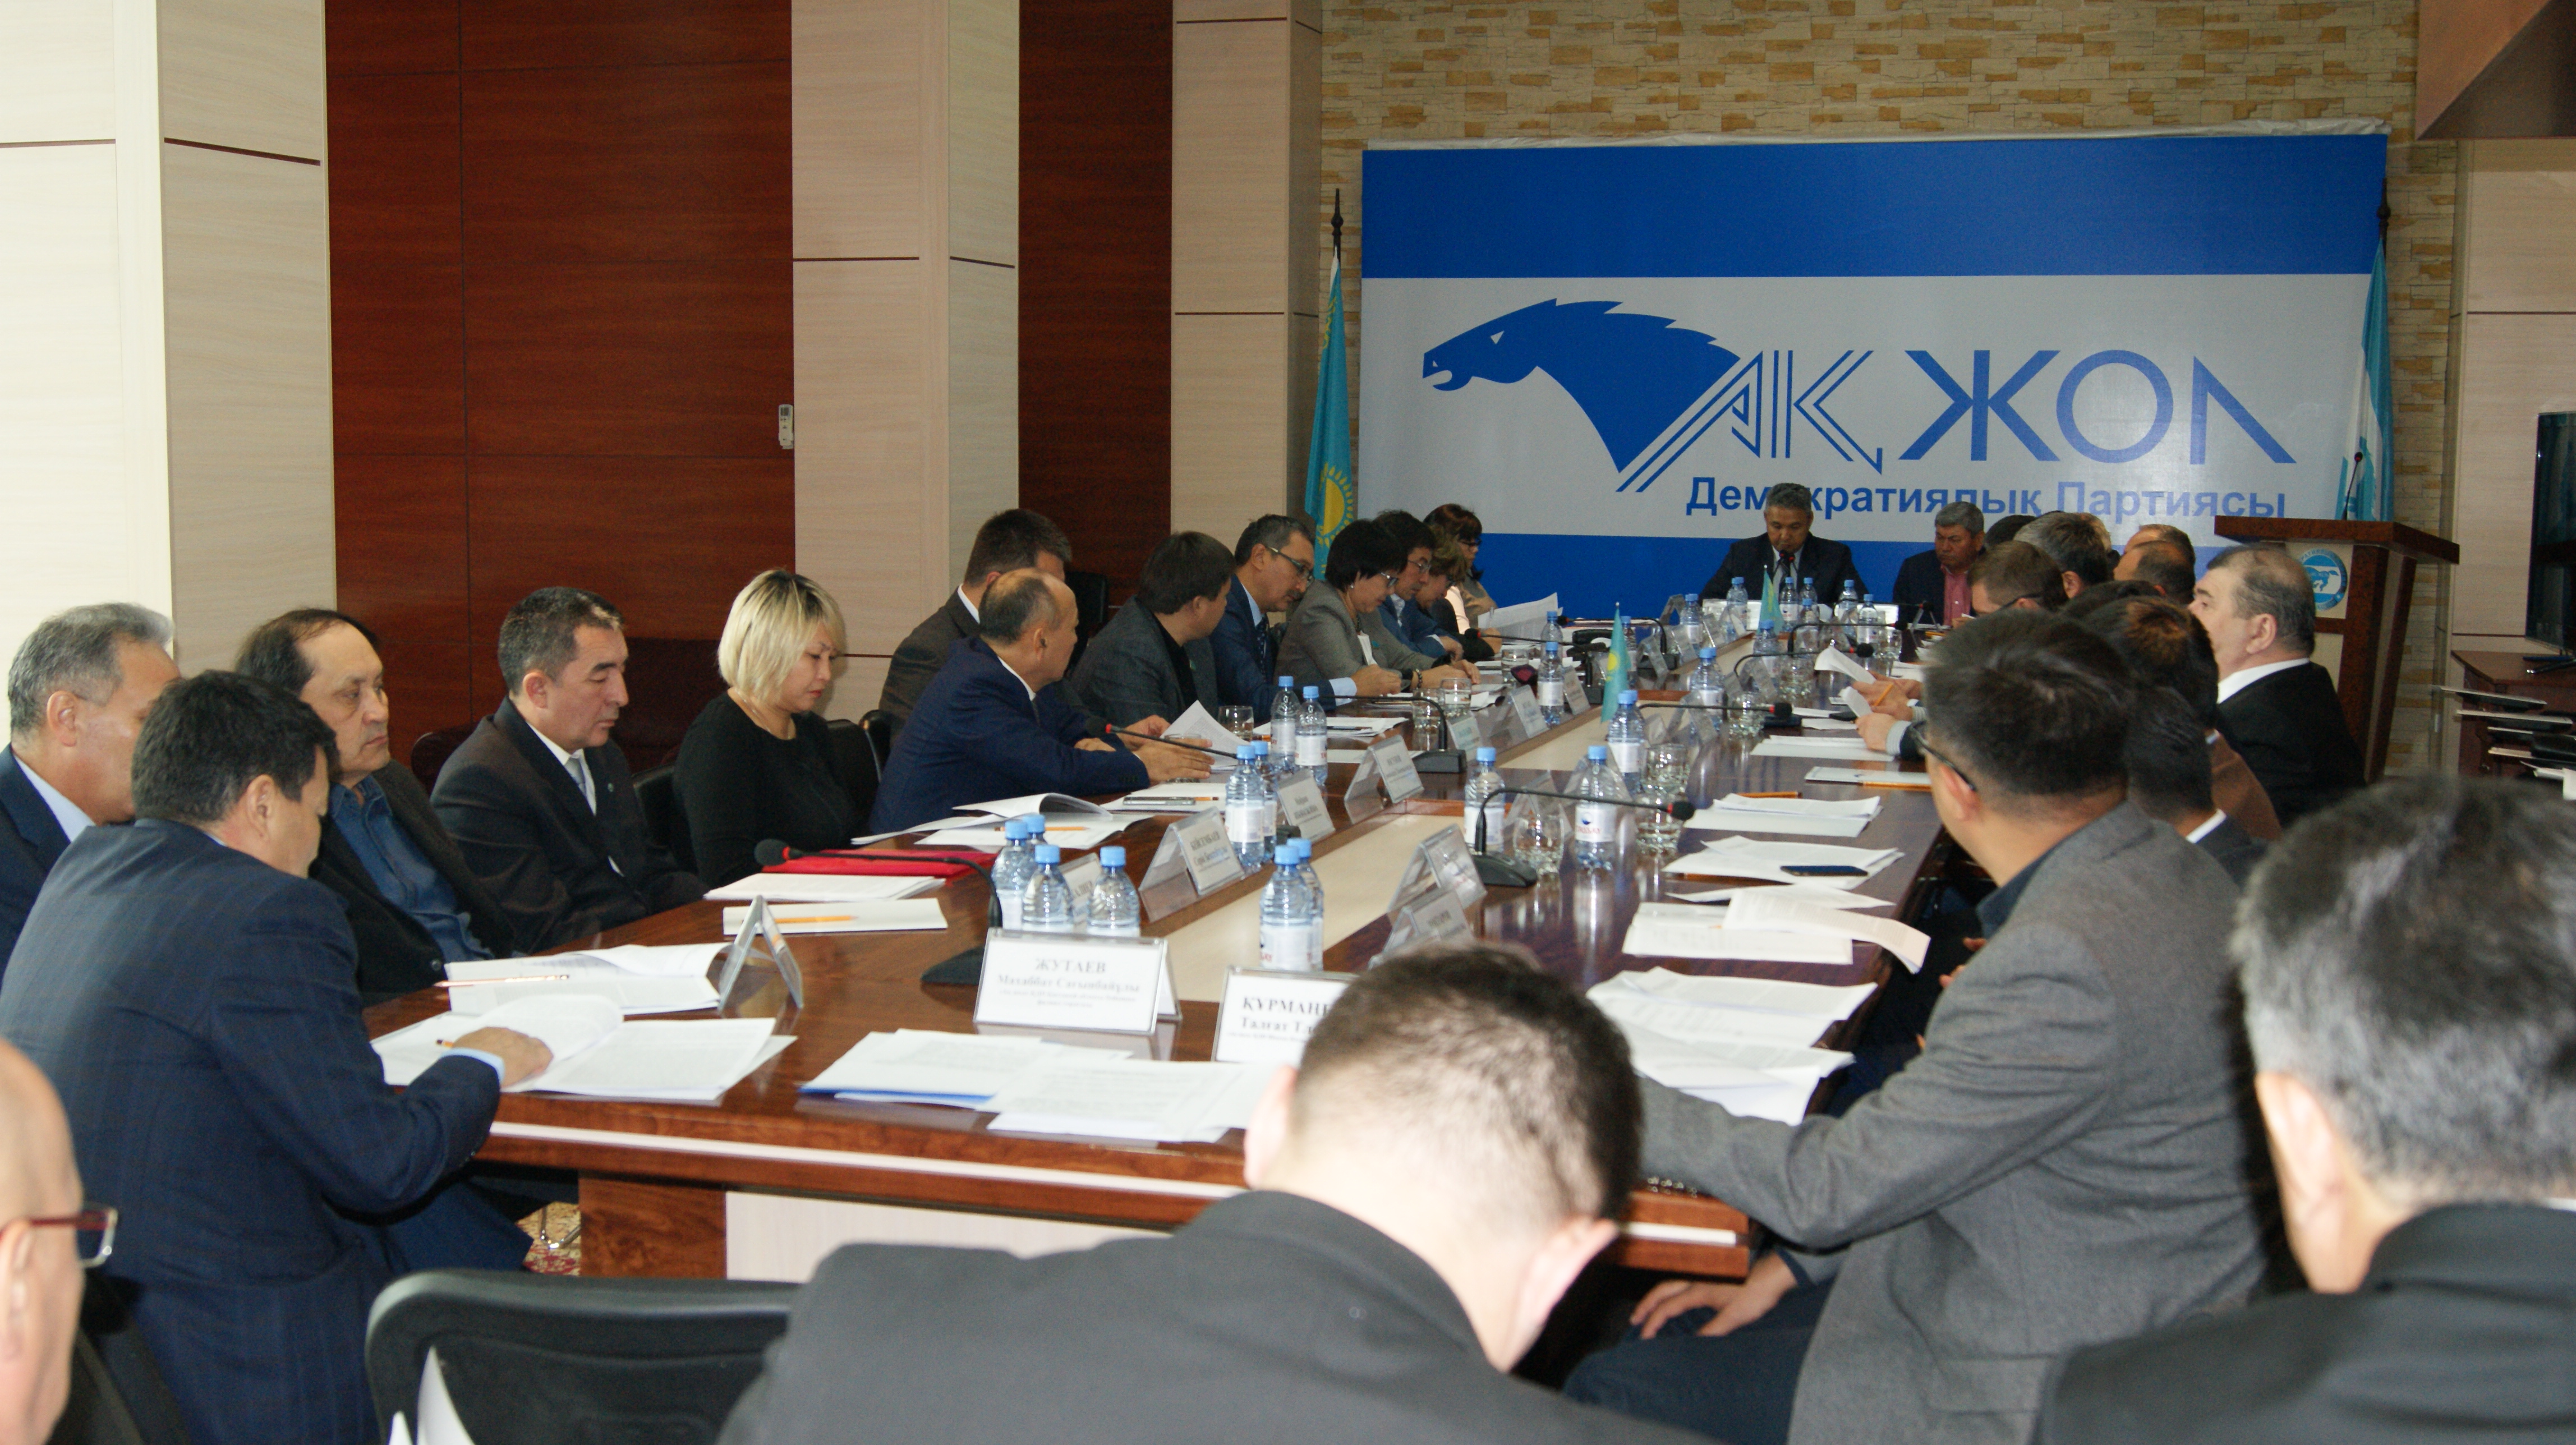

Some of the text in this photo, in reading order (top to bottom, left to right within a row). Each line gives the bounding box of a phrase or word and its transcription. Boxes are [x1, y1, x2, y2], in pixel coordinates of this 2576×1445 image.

[1898, 349, 2297, 465] ЖОЛ
[1686, 477, 2285, 524] Демкратиялық Партиясы
[1035, 958, 1107, 974] ЖУТАЕВ
